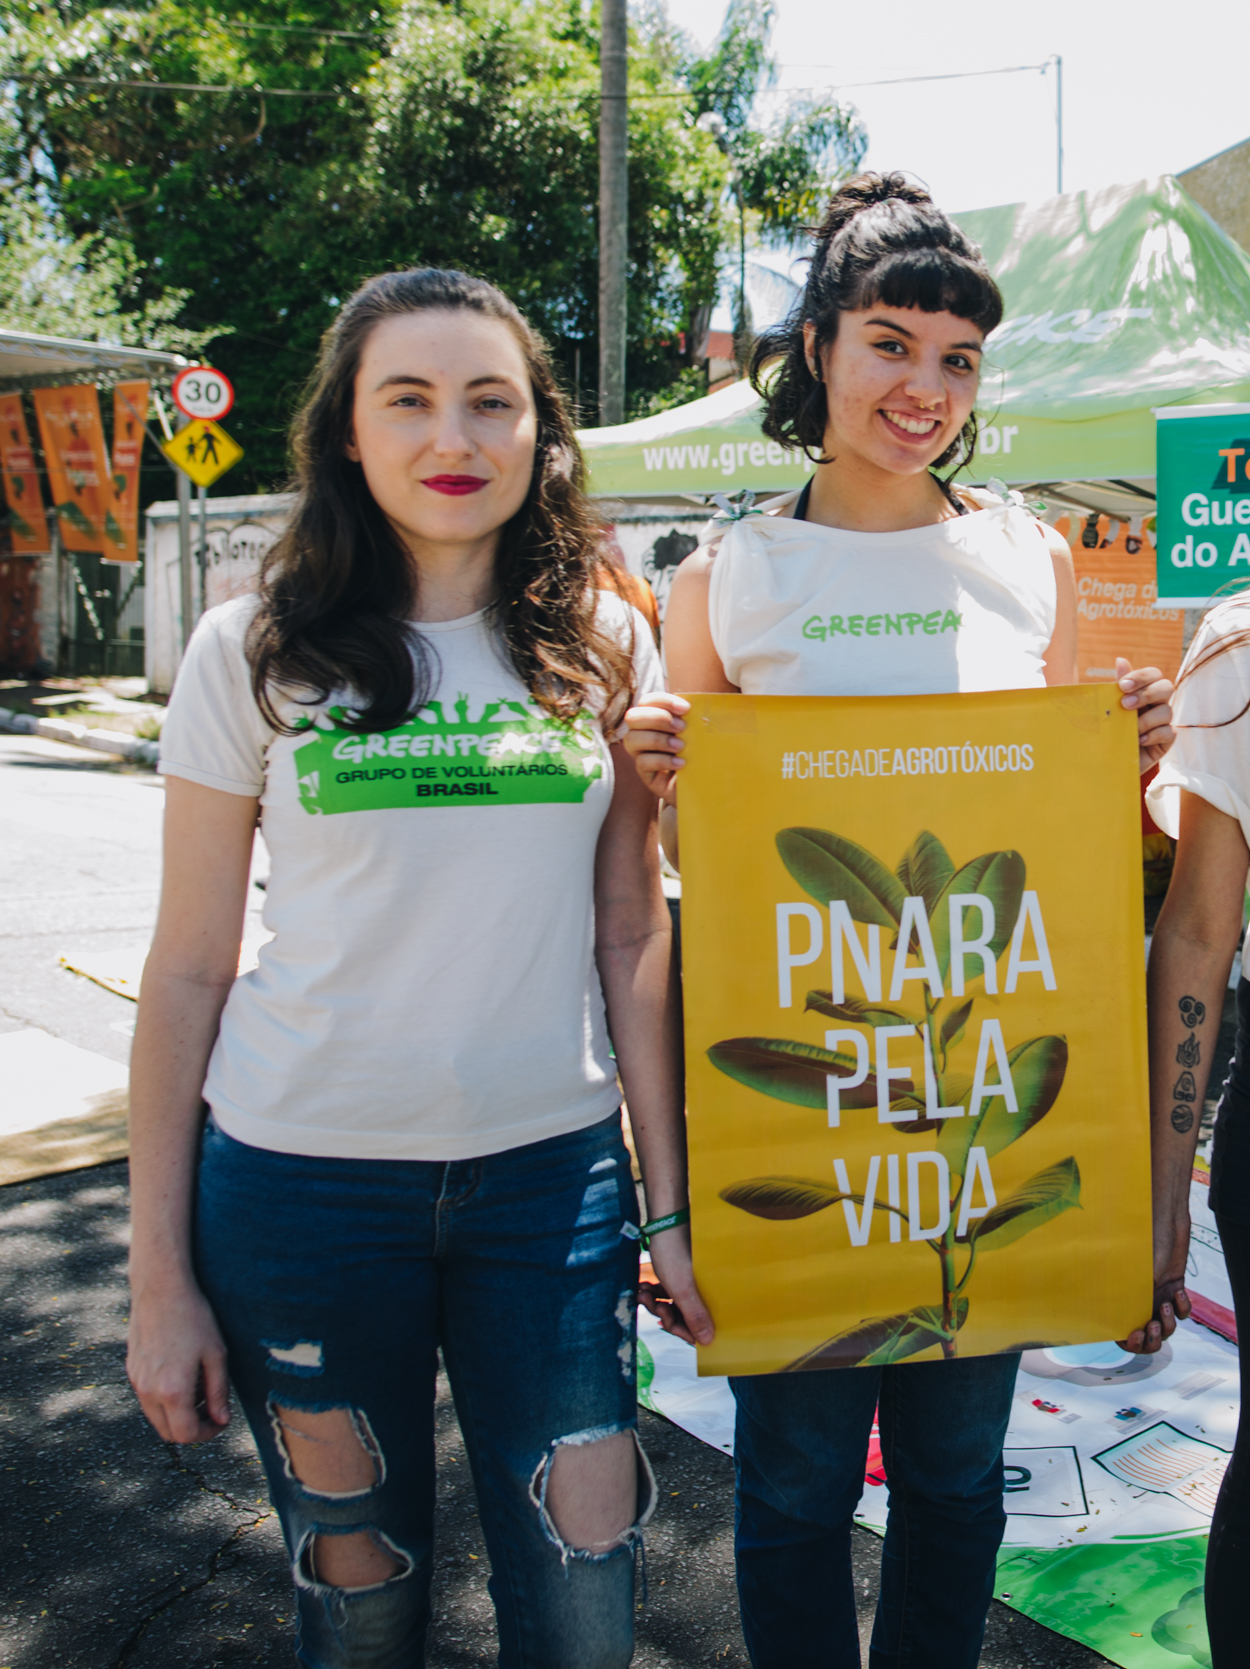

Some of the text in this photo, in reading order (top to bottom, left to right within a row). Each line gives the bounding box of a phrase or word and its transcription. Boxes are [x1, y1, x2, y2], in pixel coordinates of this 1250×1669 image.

[185, 379, 221, 404] 30
[1171, 535, 1218, 568] do
[1078, 577, 1158, 602] Chega d
[802, 609, 964, 642] GREENPEA
[332, 730, 567, 764] GREENPEACE
[781, 740, 1035, 779] #CHEGADEAGROTÓXICOS
[336, 762, 569, 784] GRUPO DE VOLUNTÁRIOS
[416, 782, 499, 797] BRASIL
[775, 890, 1057, 1008] PNARA
[824, 1018, 1018, 1127] PELA
[833, 1146, 997, 1246] VIDA
